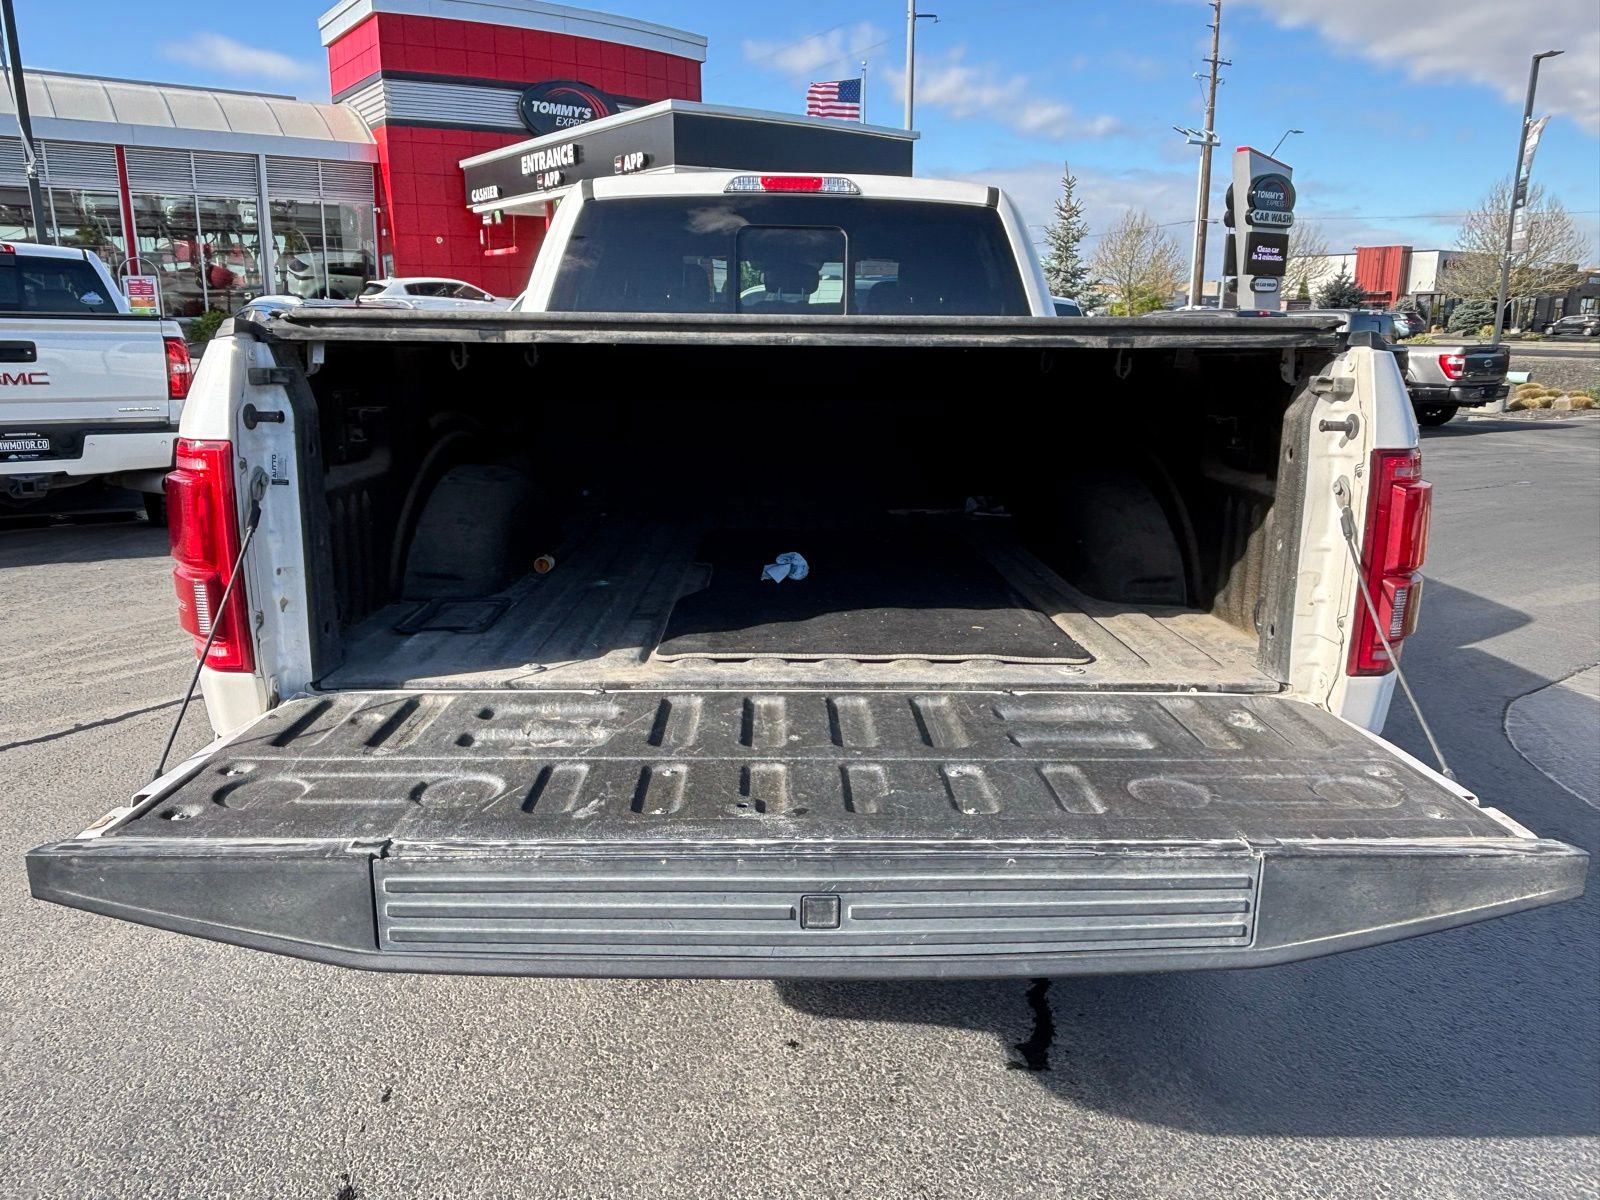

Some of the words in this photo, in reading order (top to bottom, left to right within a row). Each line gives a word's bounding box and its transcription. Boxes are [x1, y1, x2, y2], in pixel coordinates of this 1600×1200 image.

[532, 100, 592, 119] TOMMY'S
[521, 143, 574, 175] ENTRANCE
[623, 152, 644, 171] APP
[543, 171, 561, 187] APP
[471, 185, 499, 202] CASHIER
[1257, 190, 1284, 200] TOMMY'S
[1254, 211, 1270, 222] CAR
[1271, 213, 1292, 223] WASH
[0, 372, 50, 386] MC
